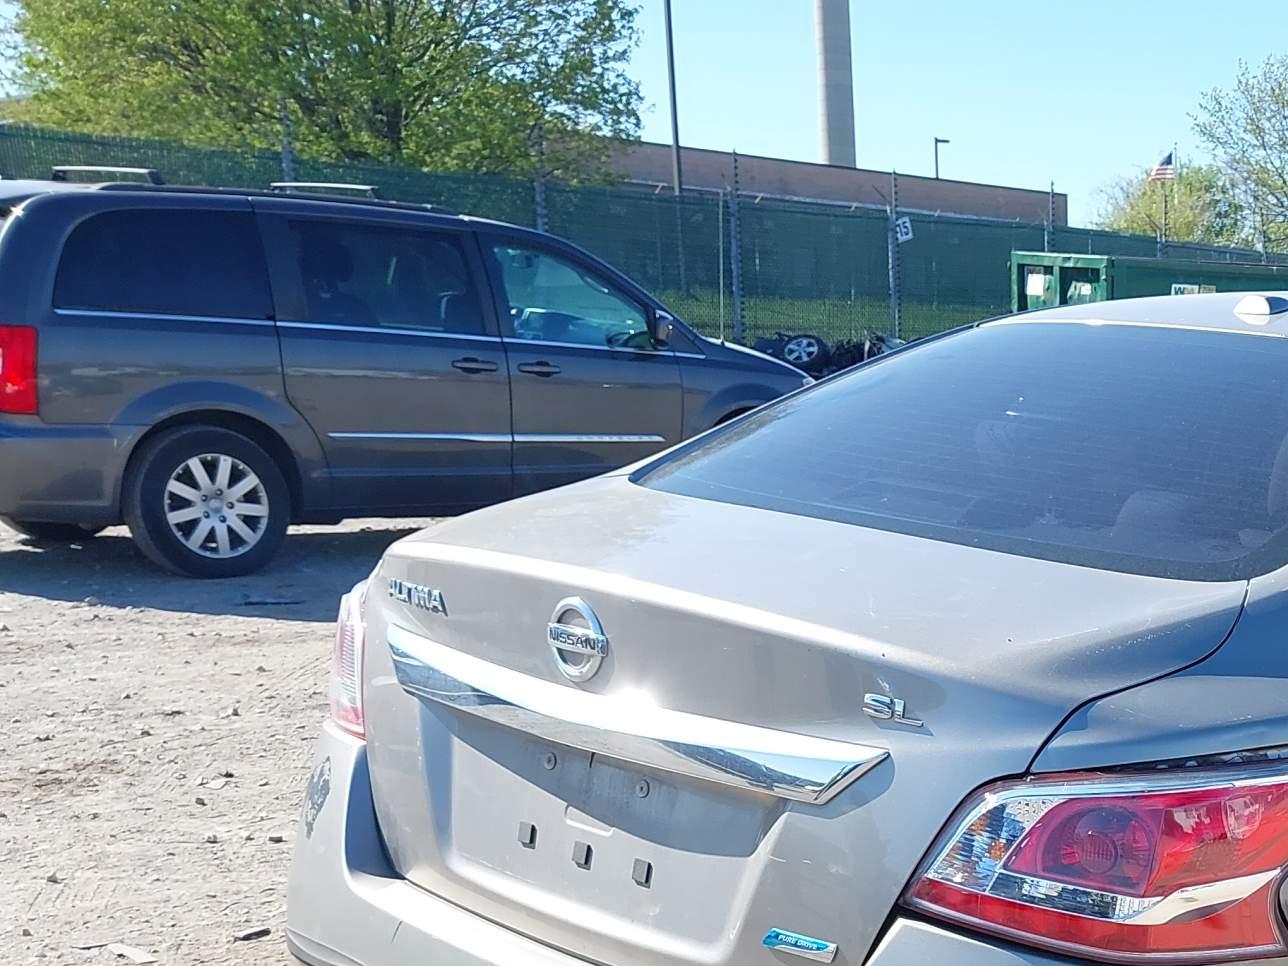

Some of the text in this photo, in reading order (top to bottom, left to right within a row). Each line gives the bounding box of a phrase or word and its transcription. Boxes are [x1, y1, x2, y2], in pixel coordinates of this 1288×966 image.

[549, 626, 597, 651] NISSAN
[862, 692, 925, 728] SL
[777, 933, 819, 951] PURE DRIVE
